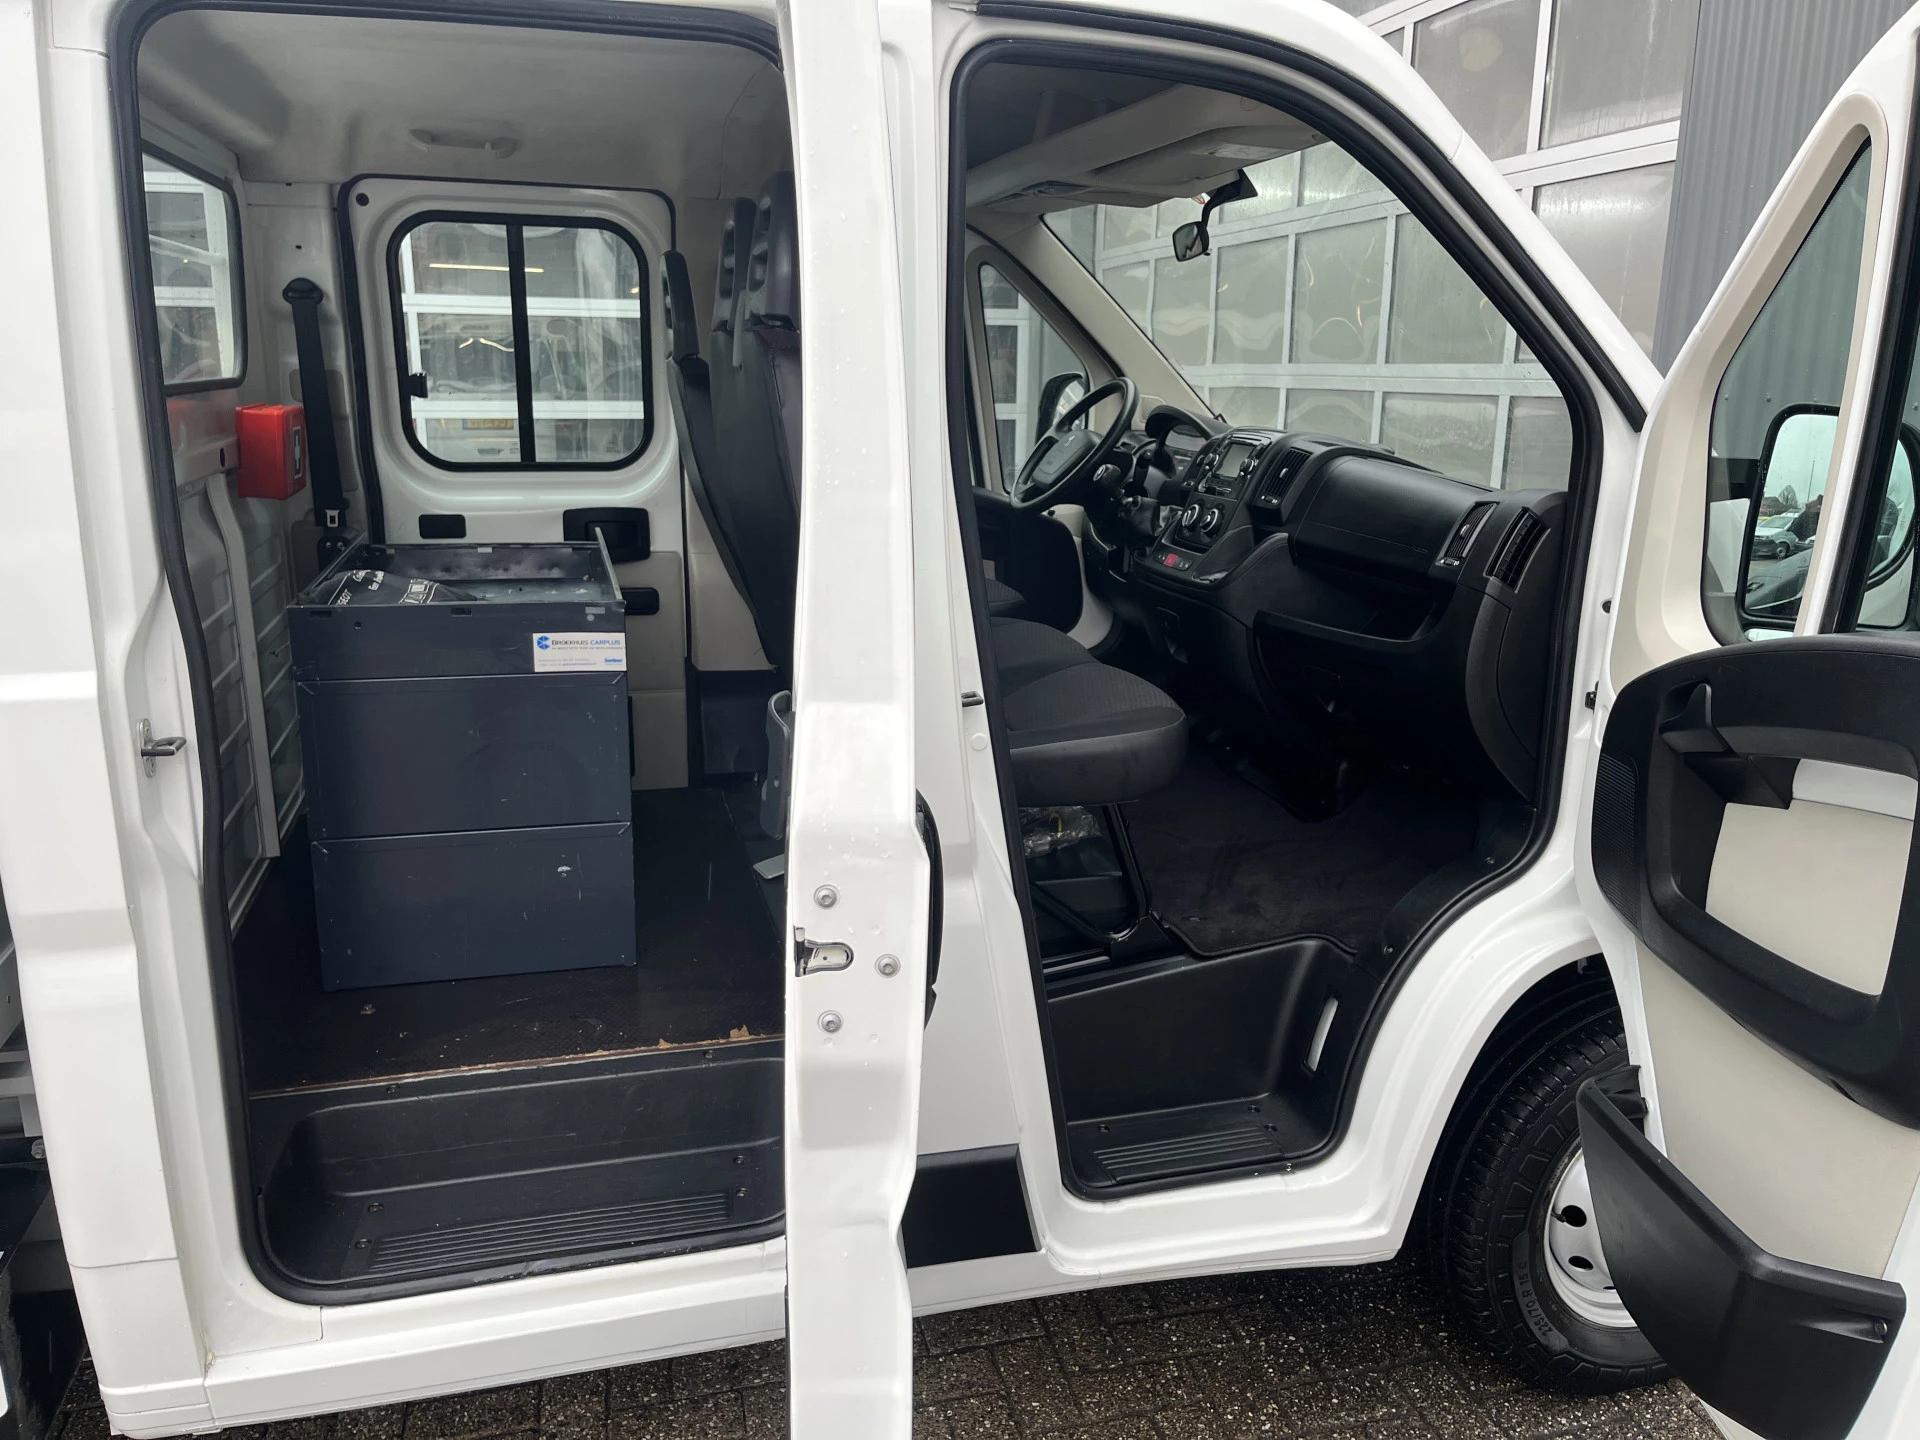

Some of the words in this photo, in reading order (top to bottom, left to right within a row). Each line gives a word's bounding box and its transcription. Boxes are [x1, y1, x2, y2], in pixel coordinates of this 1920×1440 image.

[1518, 1273, 1529, 1286] 15
[1521, 1287, 1533, 1298] R
[1525, 1300, 1553, 1336] 225/70
